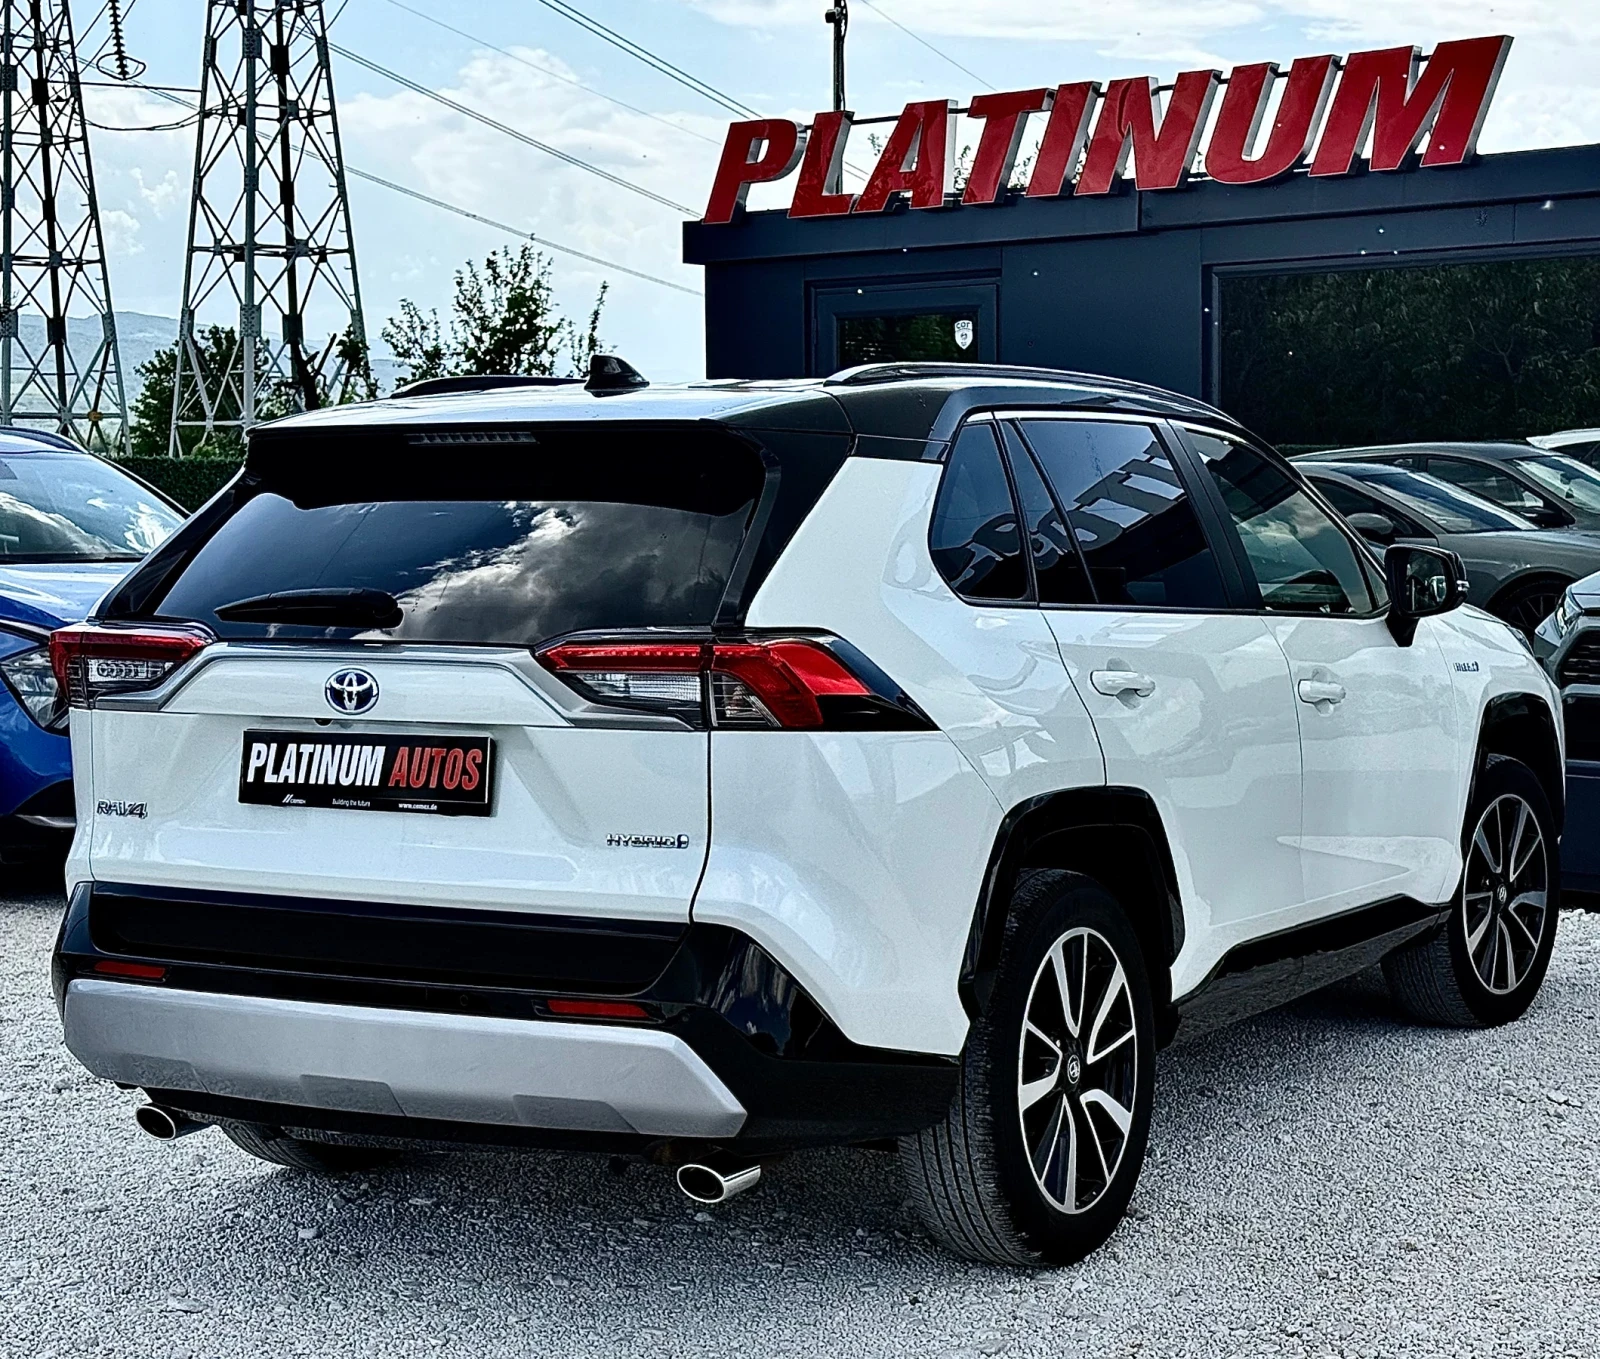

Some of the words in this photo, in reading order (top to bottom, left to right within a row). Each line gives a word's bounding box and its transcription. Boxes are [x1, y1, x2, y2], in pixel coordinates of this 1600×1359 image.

[703, 35, 1514, 225] PLATINUM
[247, 743, 386, 786] PLATINUM
[388, 747, 482, 790] AUTOS
[96, 799, 148, 819] RAV4
[606, 833, 677, 849] HYBRID
